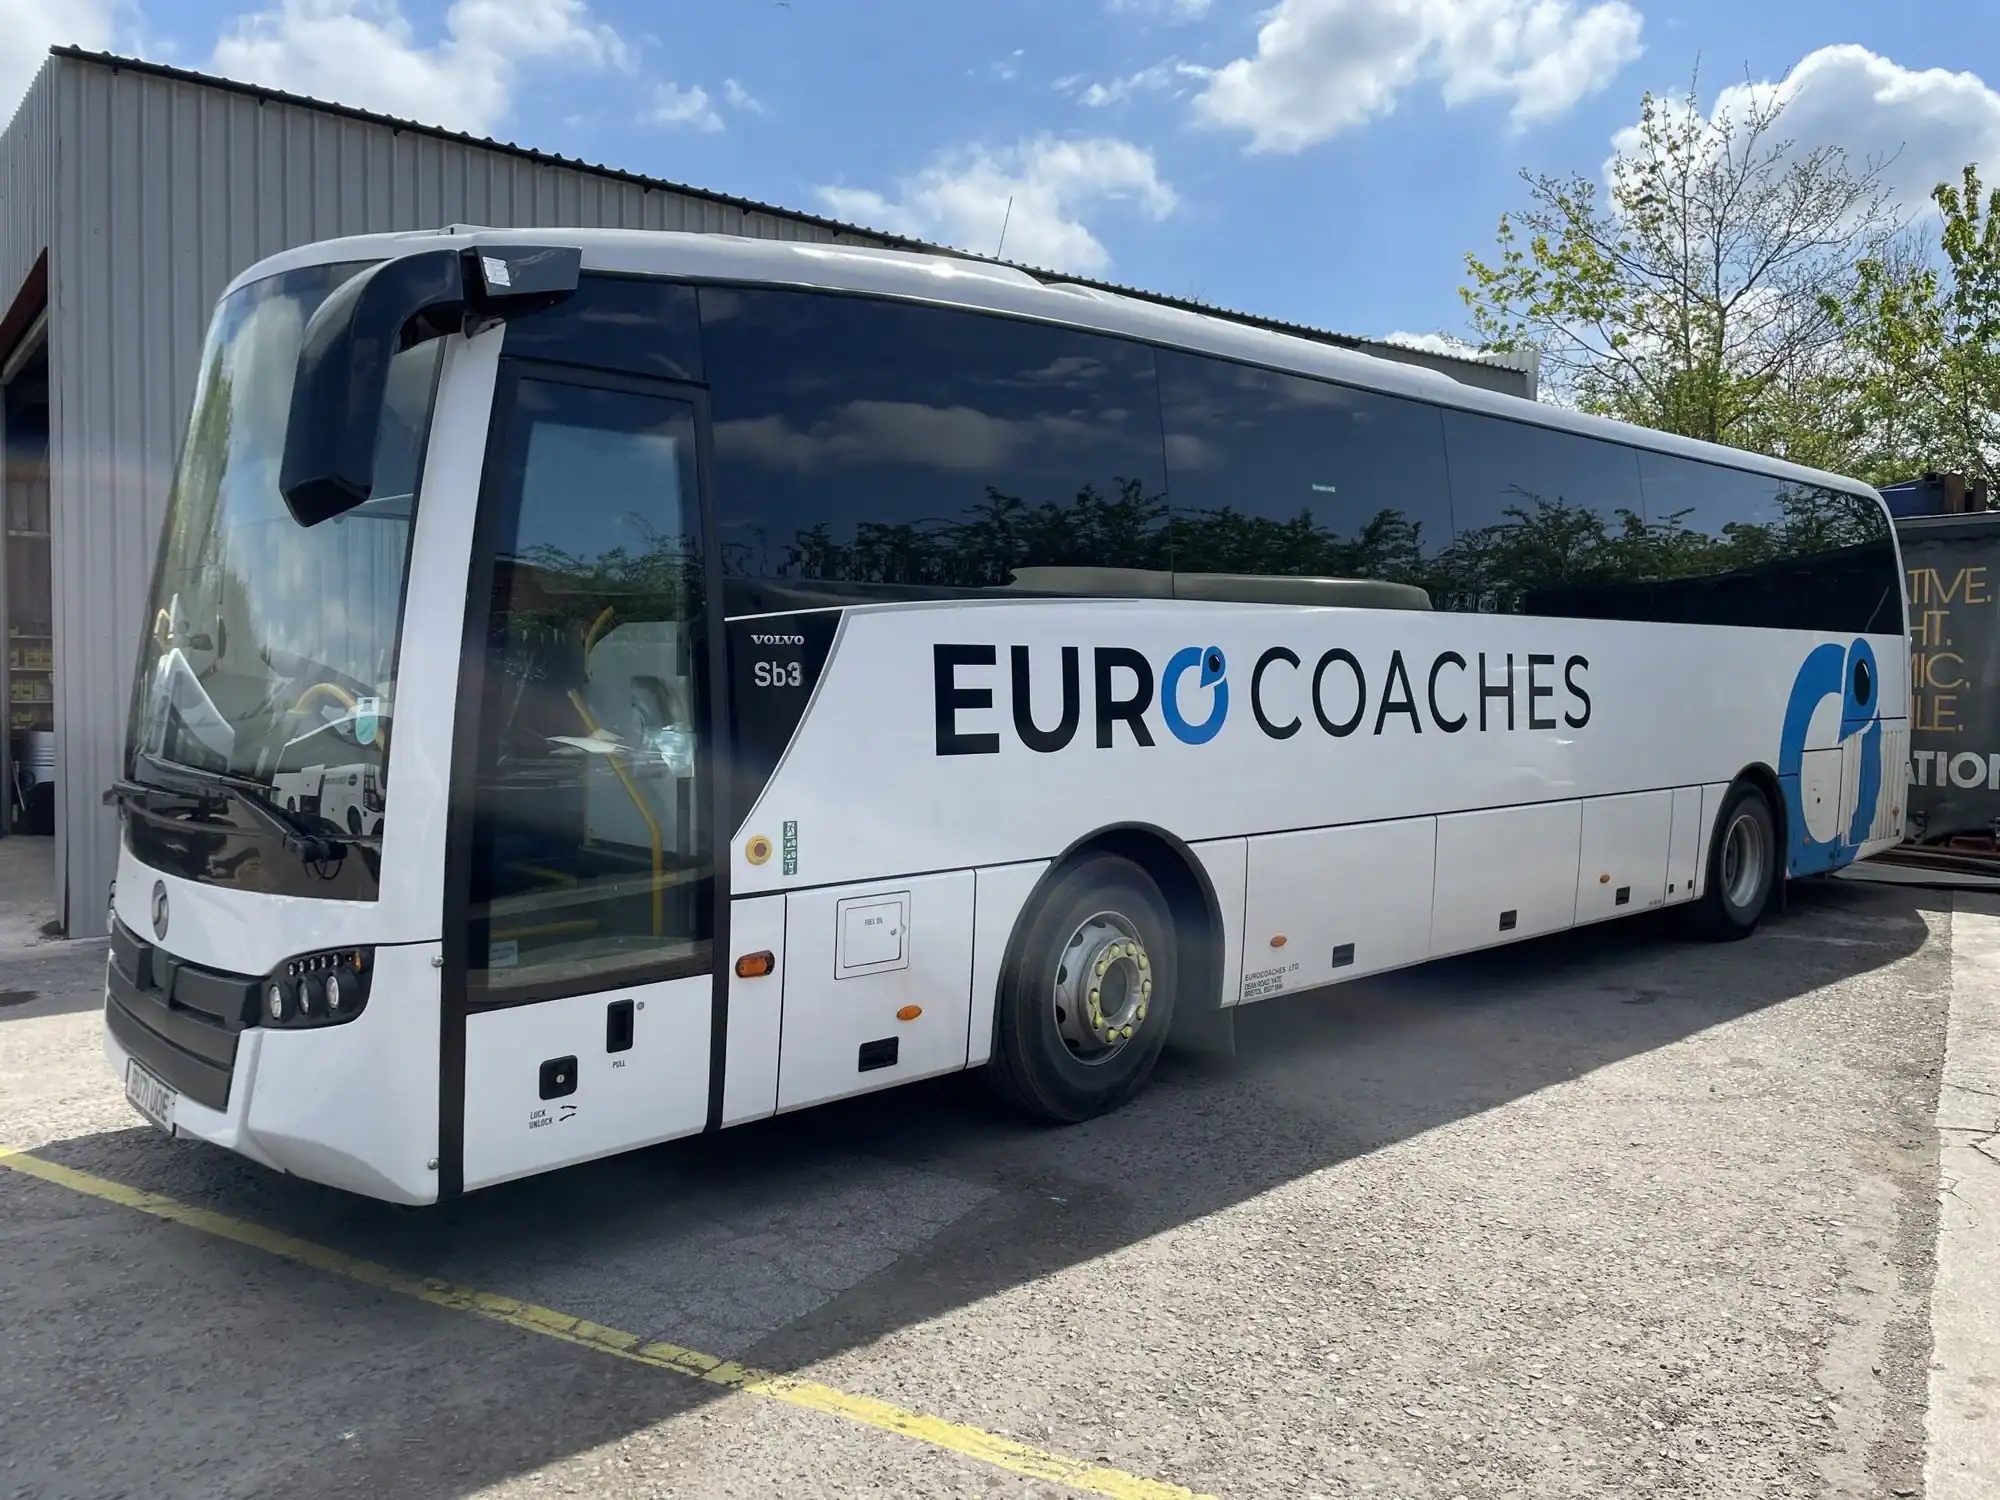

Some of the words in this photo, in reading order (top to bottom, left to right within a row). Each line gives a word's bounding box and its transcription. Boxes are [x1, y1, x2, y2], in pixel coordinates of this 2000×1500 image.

[1906, 567, 1992, 604] TIVE.
[750, 634, 805, 646] VOLVO
[754, 661, 804, 687] Sb3
[933, 644, 1229, 756] EURO
[1250, 646, 1592, 740] COACHES
[1244, 966, 1286, 982] EUROCOACHES
[1288, 962, 1300, 972] LTD
[612, 1060, 626, 1069] PULL
[530, 1109, 546, 1120] LOCK
[528, 1117, 553, 1129] UNLOCK
